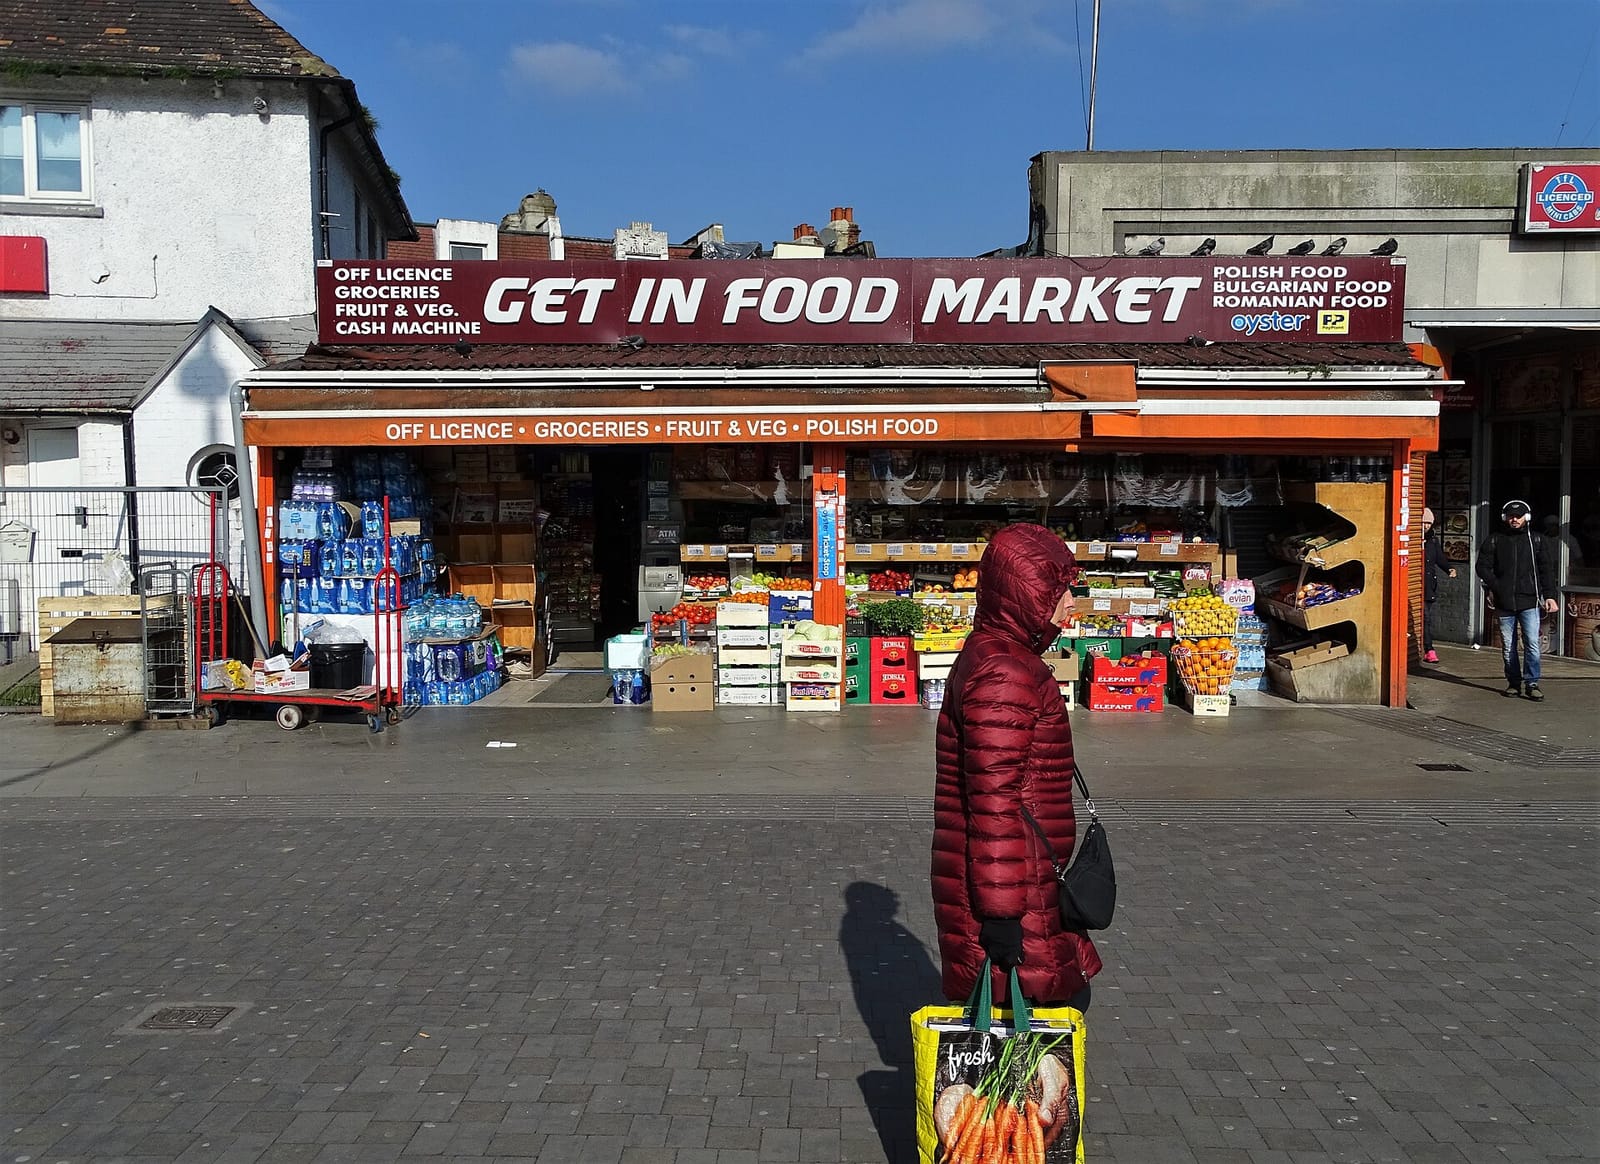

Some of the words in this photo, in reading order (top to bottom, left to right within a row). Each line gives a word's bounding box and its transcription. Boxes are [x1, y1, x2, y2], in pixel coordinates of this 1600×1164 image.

[1538, 193, 1592, 202] LICENCED
[1546, 205, 1562, 220] MINI
[1563, 205, 1583, 220] CABS
[334, 268, 370, 281] OFF
[376, 268, 453, 281] LICENCE
[1213, 266, 1284, 278] POLISH
[1290, 266, 1348, 278] FOOD
[334, 286, 440, 299] GROCERIES
[1213, 281, 1328, 293] BULGARIAN
[1335, 281, 1392, 293] FOOD
[483, 277, 616, 325] GET
[627, 277, 707, 324] IN
[722, 277, 899, 324] FOOD
[921, 276, 1202, 324] MARKET
[1212, 295, 1324, 308] ROMANIAN
[1330, 295, 1388, 308] FOOD
[335, 304, 389, 317] FRUIT
[394, 304, 409, 317] &
[414, 304, 459, 317] VEG.
[335, 321, 386, 334] CASH
[392, 321, 481, 334] MACHINE
[1231, 311, 1305, 335] oyster
[385, 423, 425, 440] OFF
[430, 422, 513, 439] LICENCE
[534, 420, 649, 438] GROCERIES
[666, 420, 724, 437] FRUIT
[727, 420, 741, 436] &
[746, 419, 787, 436] VEG
[806, 418, 877, 436] POLISH
[882, 418, 939, 435] FOOD
[658, 530, 677, 538] ATM
[1229, 594, 1252, 603] evian
[947, 1036, 995, 1081] fresh
